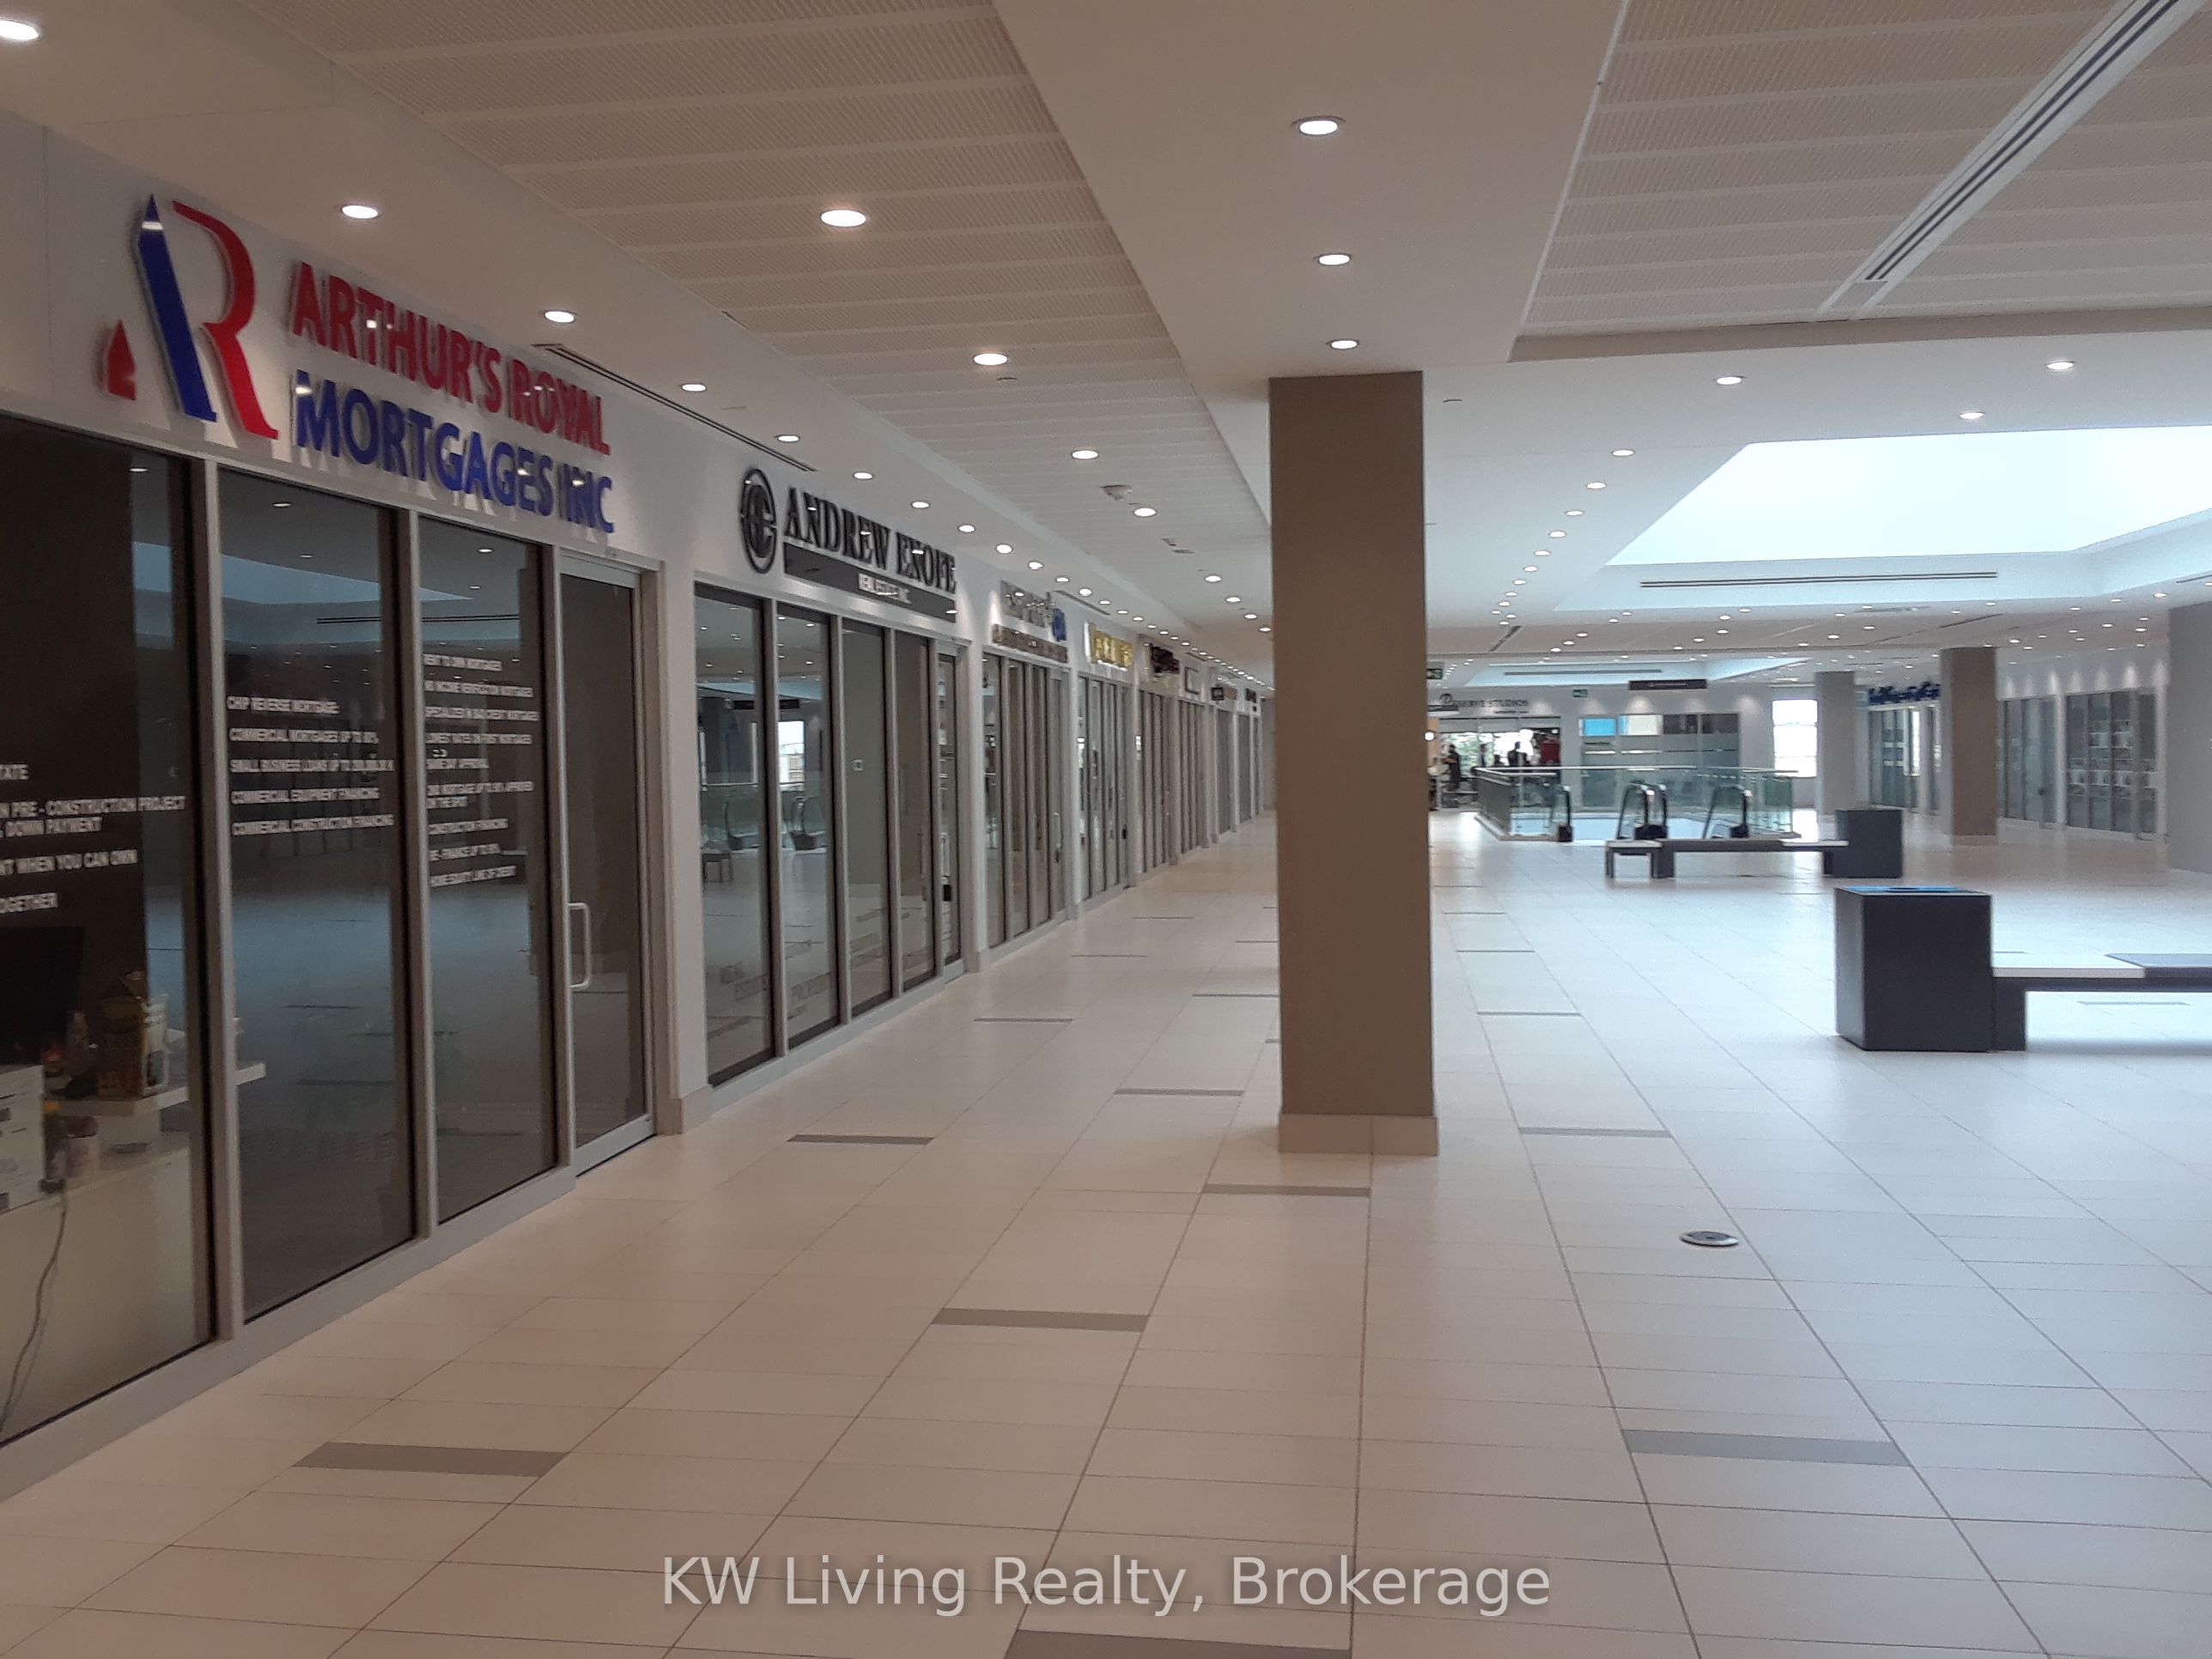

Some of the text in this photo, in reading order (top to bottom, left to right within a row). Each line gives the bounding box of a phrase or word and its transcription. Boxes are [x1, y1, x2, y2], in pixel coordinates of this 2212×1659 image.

[292, 261, 611, 456] ARTHUR'S ROYAL
[295, 369, 554, 517] MORTGAGES
[560, 462, 615, 534] INC
[784, 487, 891, 571] ANDREW
